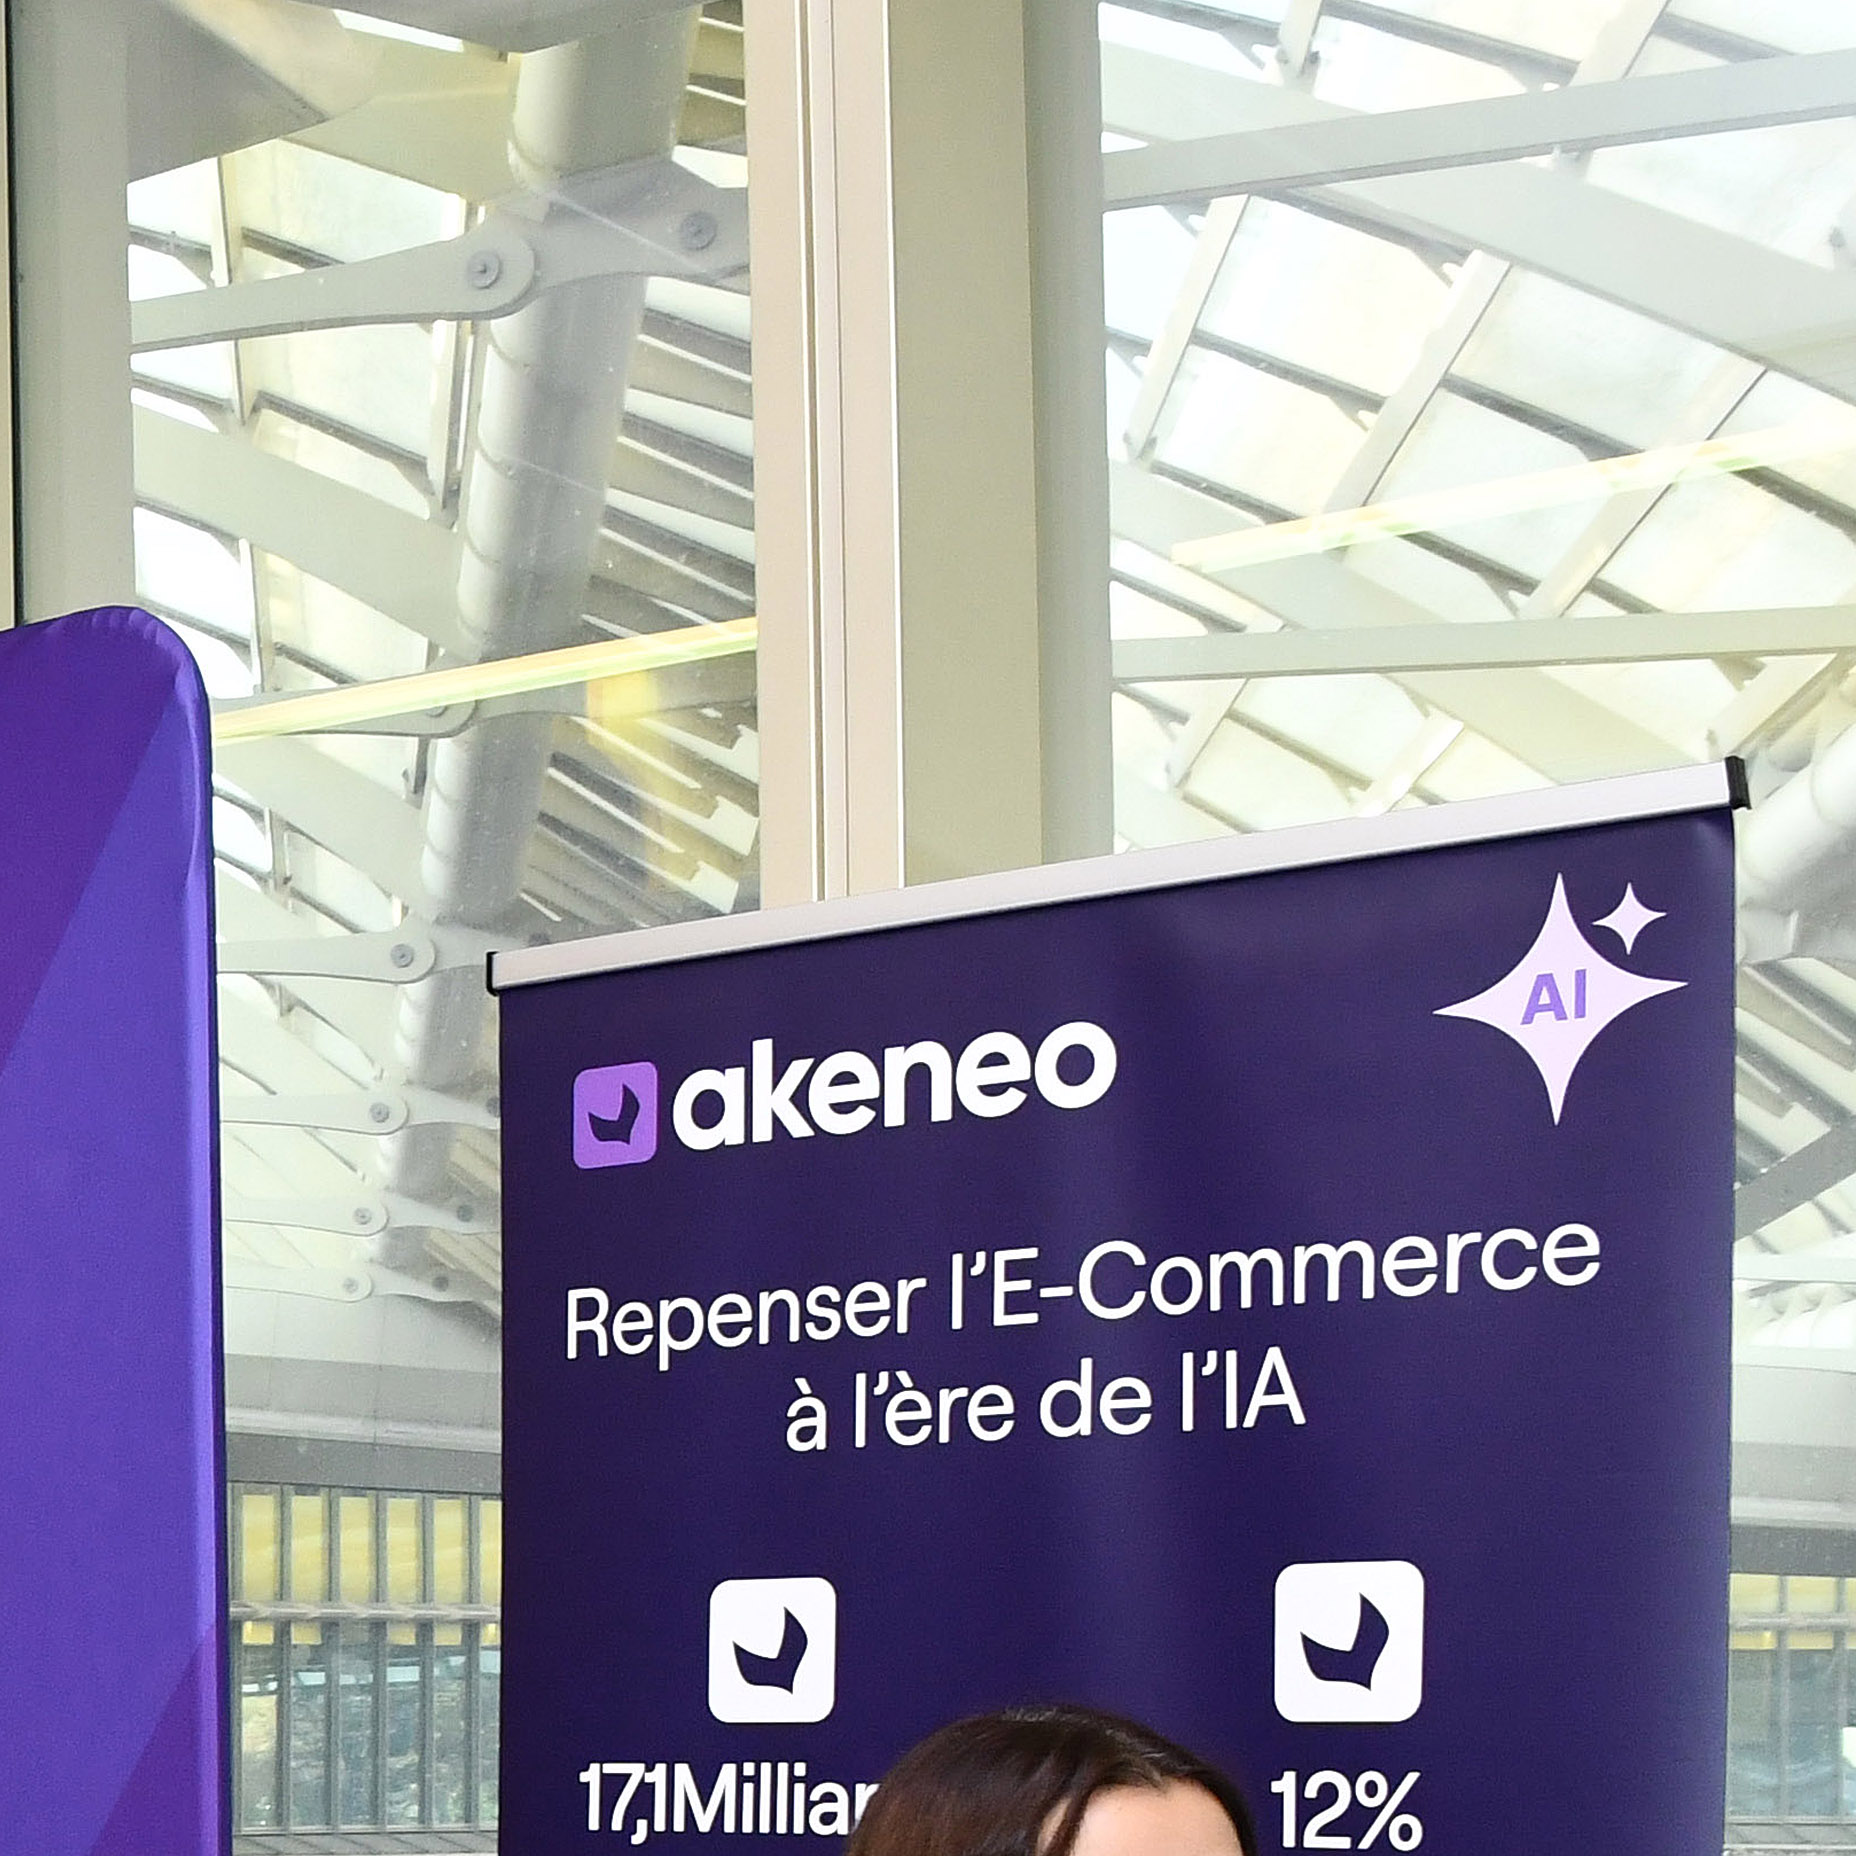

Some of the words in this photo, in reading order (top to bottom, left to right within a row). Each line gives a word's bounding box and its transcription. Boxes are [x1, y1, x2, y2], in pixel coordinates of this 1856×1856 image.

[1520, 968, 1587, 1026] AI
[672, 1021, 1117, 1151] akeneo
[567, 1277, 927, 1372] Repenser
[951, 1223, 1600, 1330] l'E-Commerce
[786, 1377, 827, 1452] à
[855, 1370, 1015, 1448] l'ère
[1039, 1357, 1152, 1438] de
[579, 1761, 882, 1845] 17,1Milliar
[1270, 1770, 1423, 1852] 12%
